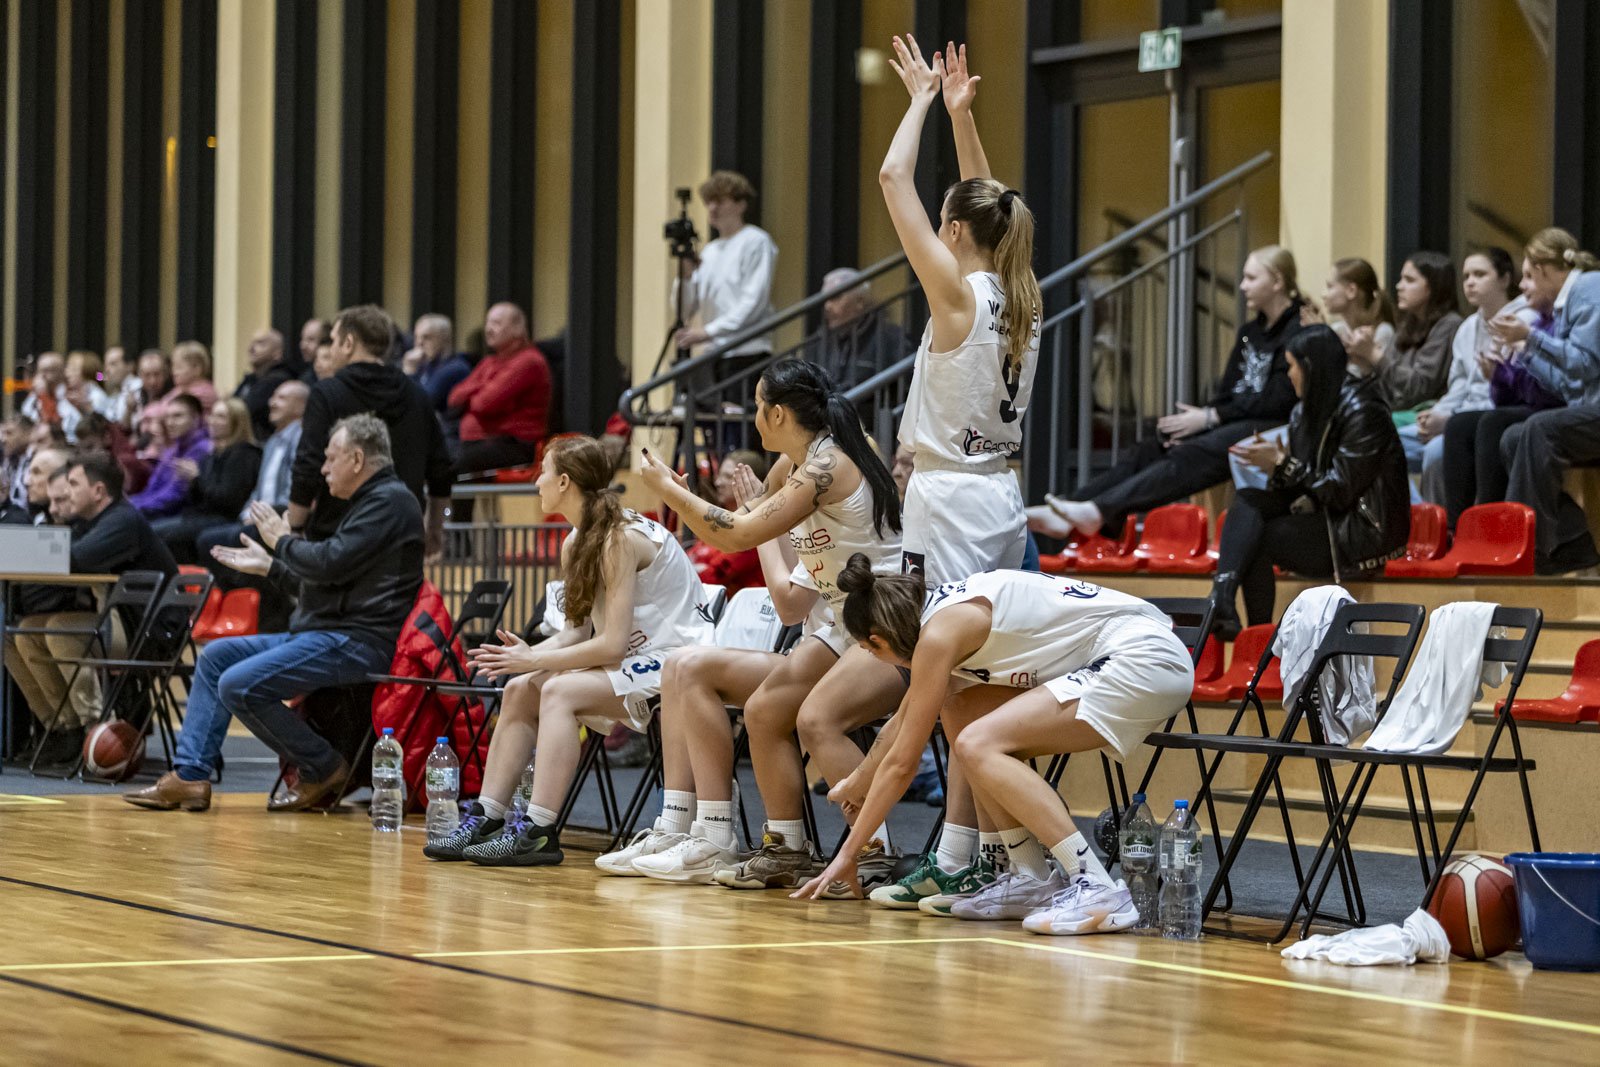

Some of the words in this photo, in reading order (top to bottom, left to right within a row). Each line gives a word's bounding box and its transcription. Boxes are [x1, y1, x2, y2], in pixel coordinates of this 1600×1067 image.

[631, 659, 662, 675] 3
[664, 804, 688, 812] didas
[980, 843, 1006, 854] JUS
